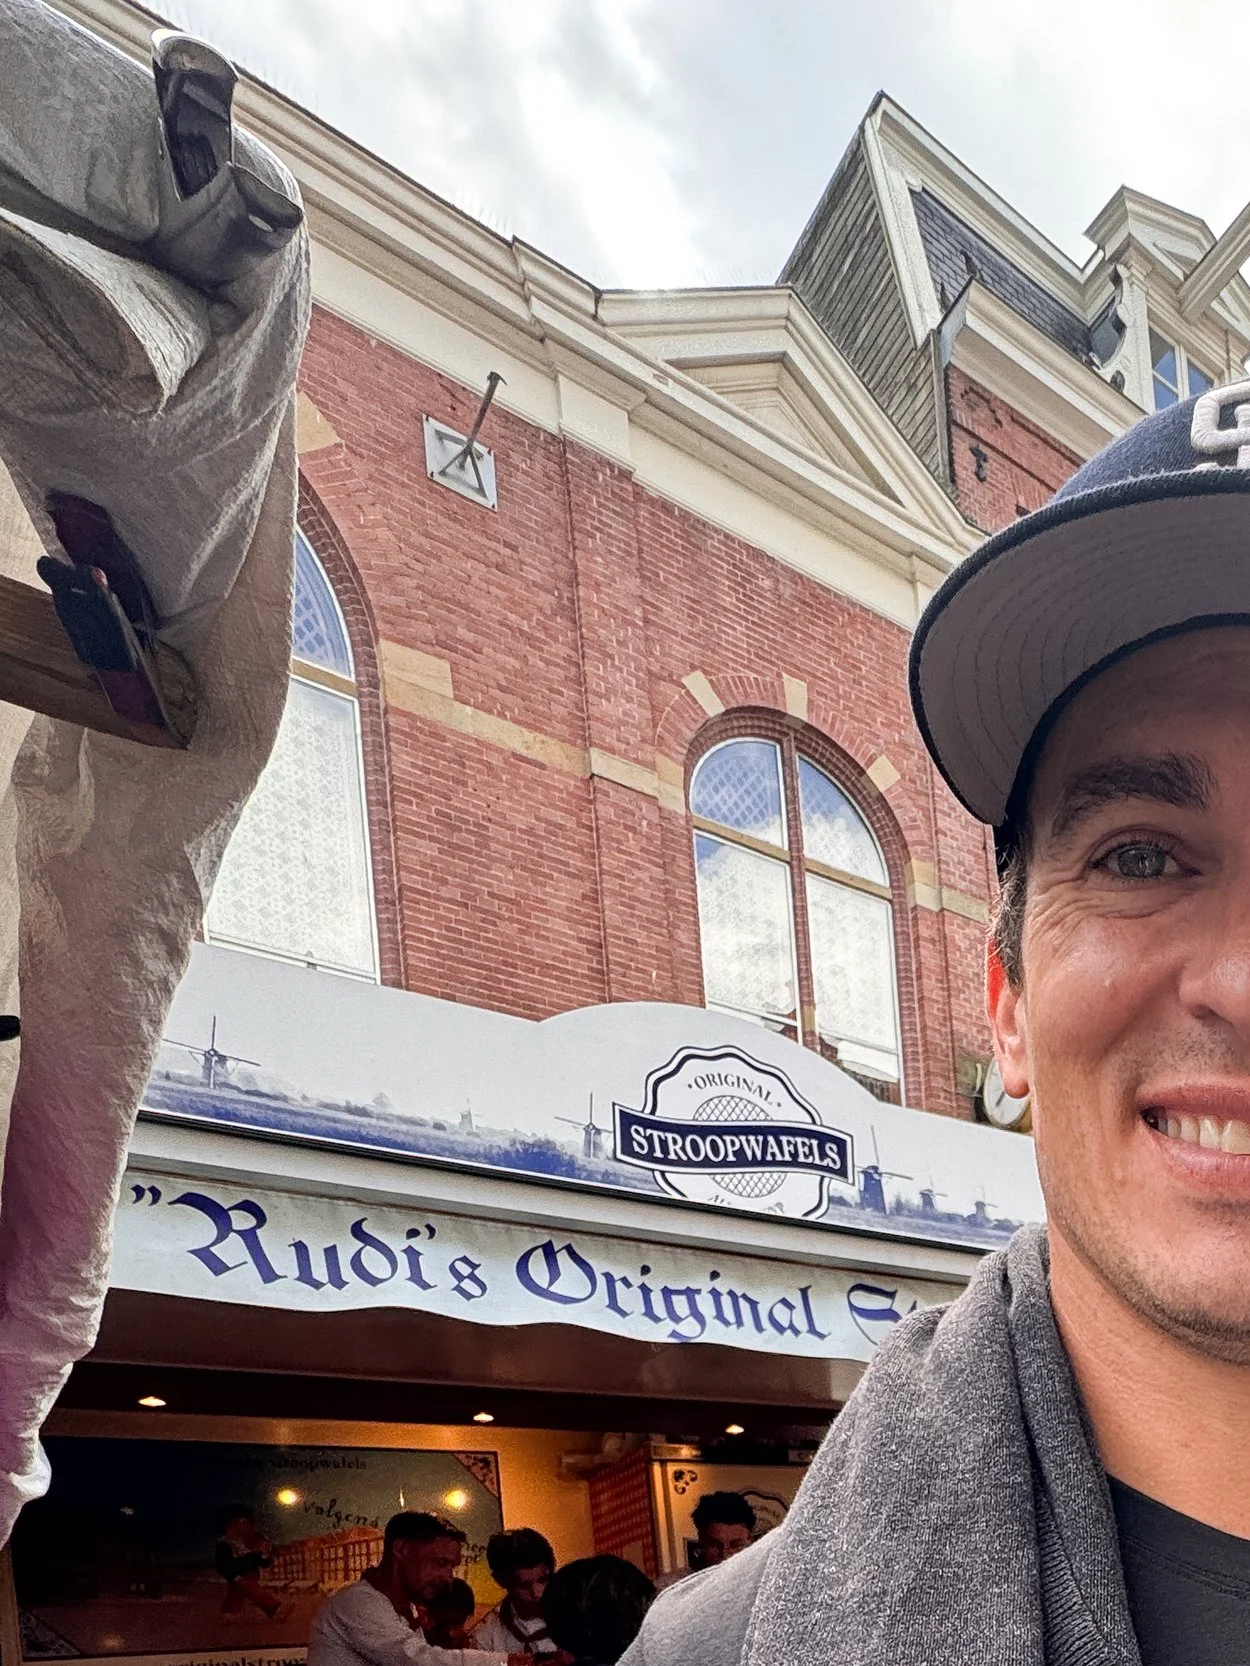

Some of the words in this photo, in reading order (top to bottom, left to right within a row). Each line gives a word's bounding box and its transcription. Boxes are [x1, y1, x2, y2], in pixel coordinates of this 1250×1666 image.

[694, 1072, 775, 1105] ORIGINAL
[630, 1124, 842, 1170] STROOPWAFELS
[515, 1239, 832, 1343] Original
[846, 1282, 917, 1346] S
[303, 1498, 381, 1529] volgens
